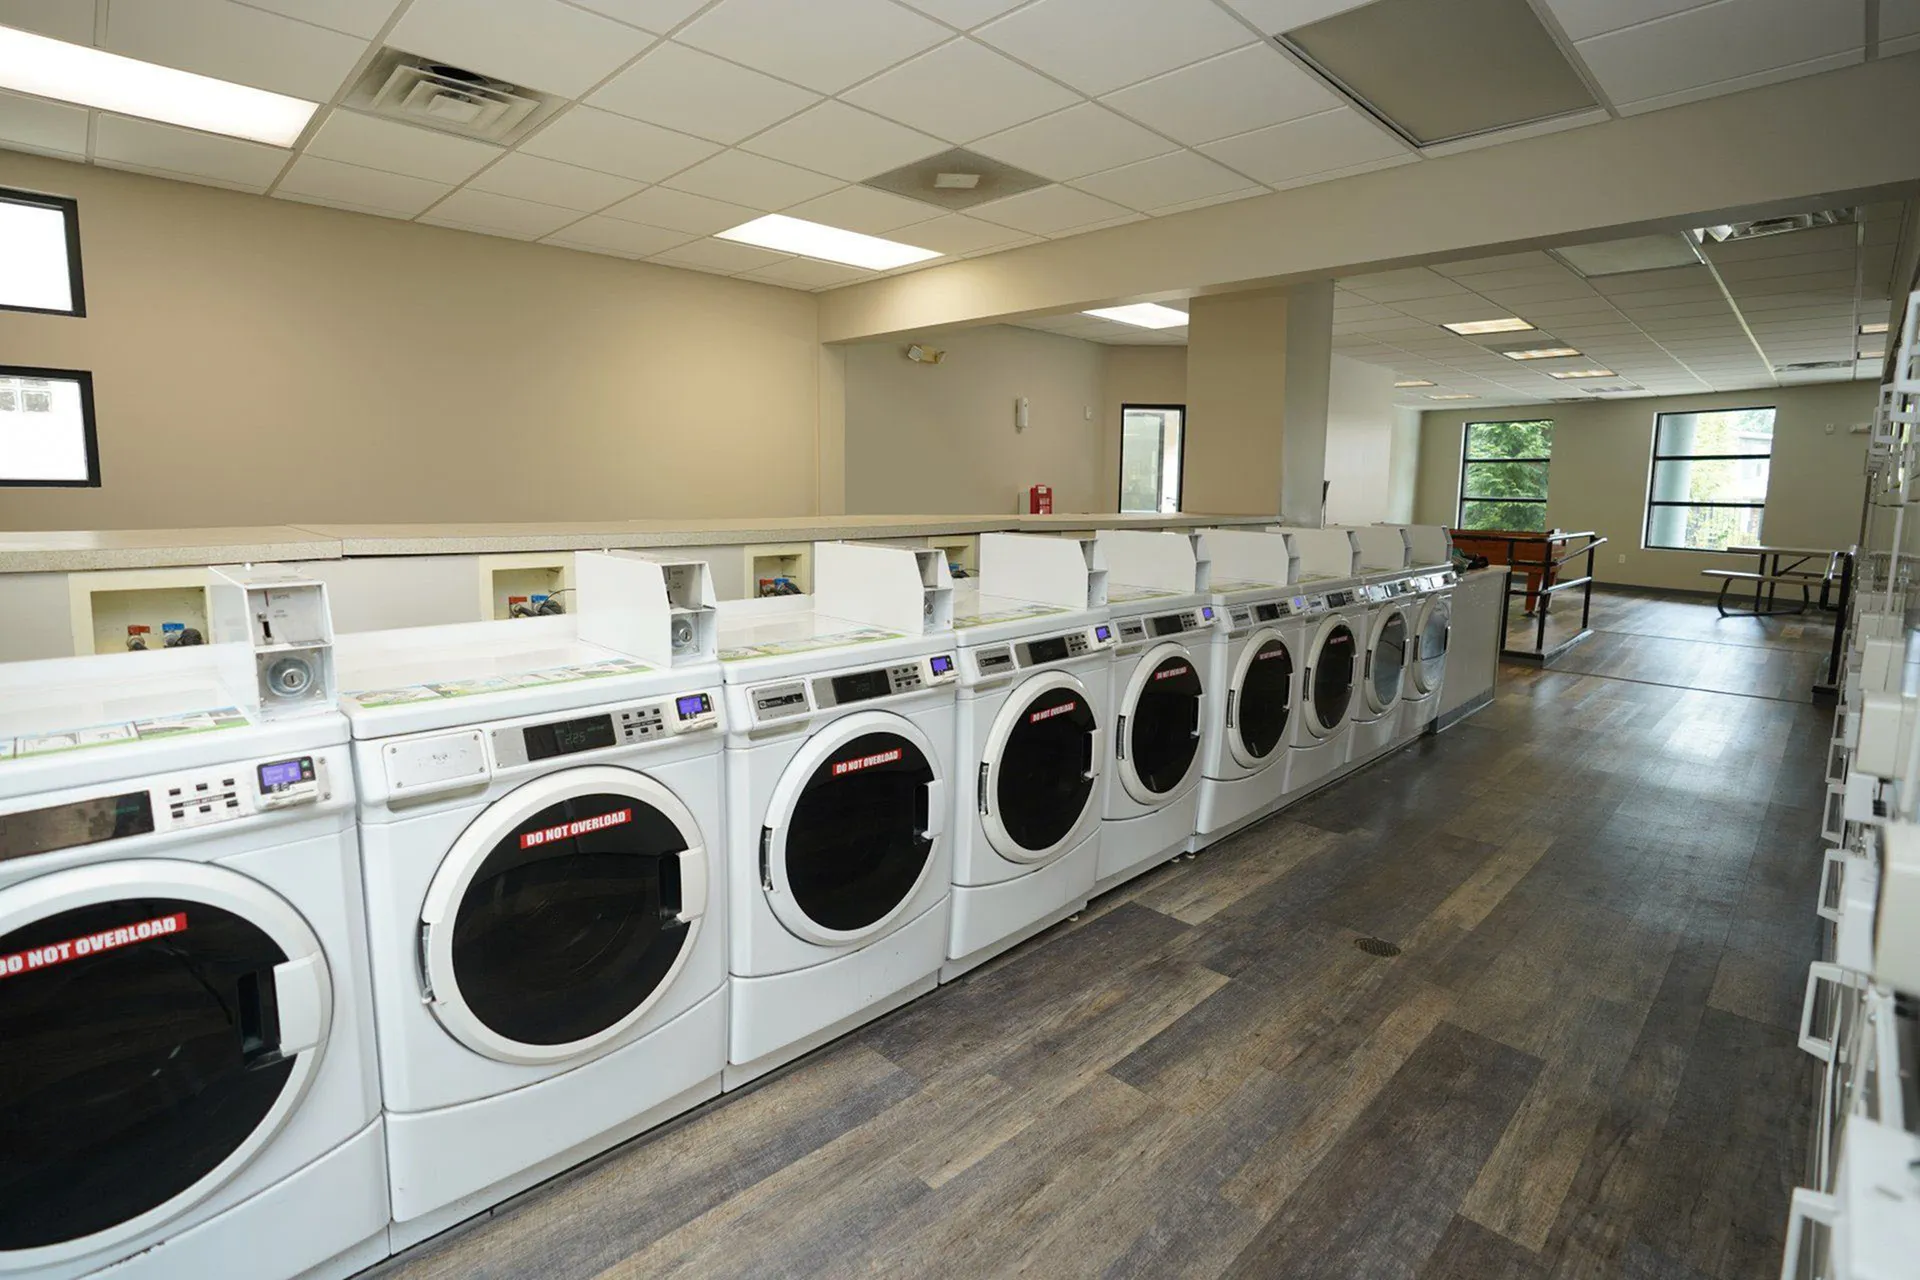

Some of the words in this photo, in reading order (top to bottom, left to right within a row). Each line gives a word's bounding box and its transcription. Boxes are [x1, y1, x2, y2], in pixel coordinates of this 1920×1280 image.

[836, 763, 847, 774] DO
[848, 759, 863, 771] NOT
[863, 750, 898, 767] OVERLOAD
[526, 832, 544, 846] DO
[545, 825, 569, 841] NOT
[570, 811, 626, 835] OVERLOAD
[28, 943, 71, 968] NOT
[75, 916, 177, 955] OVERLOAD
